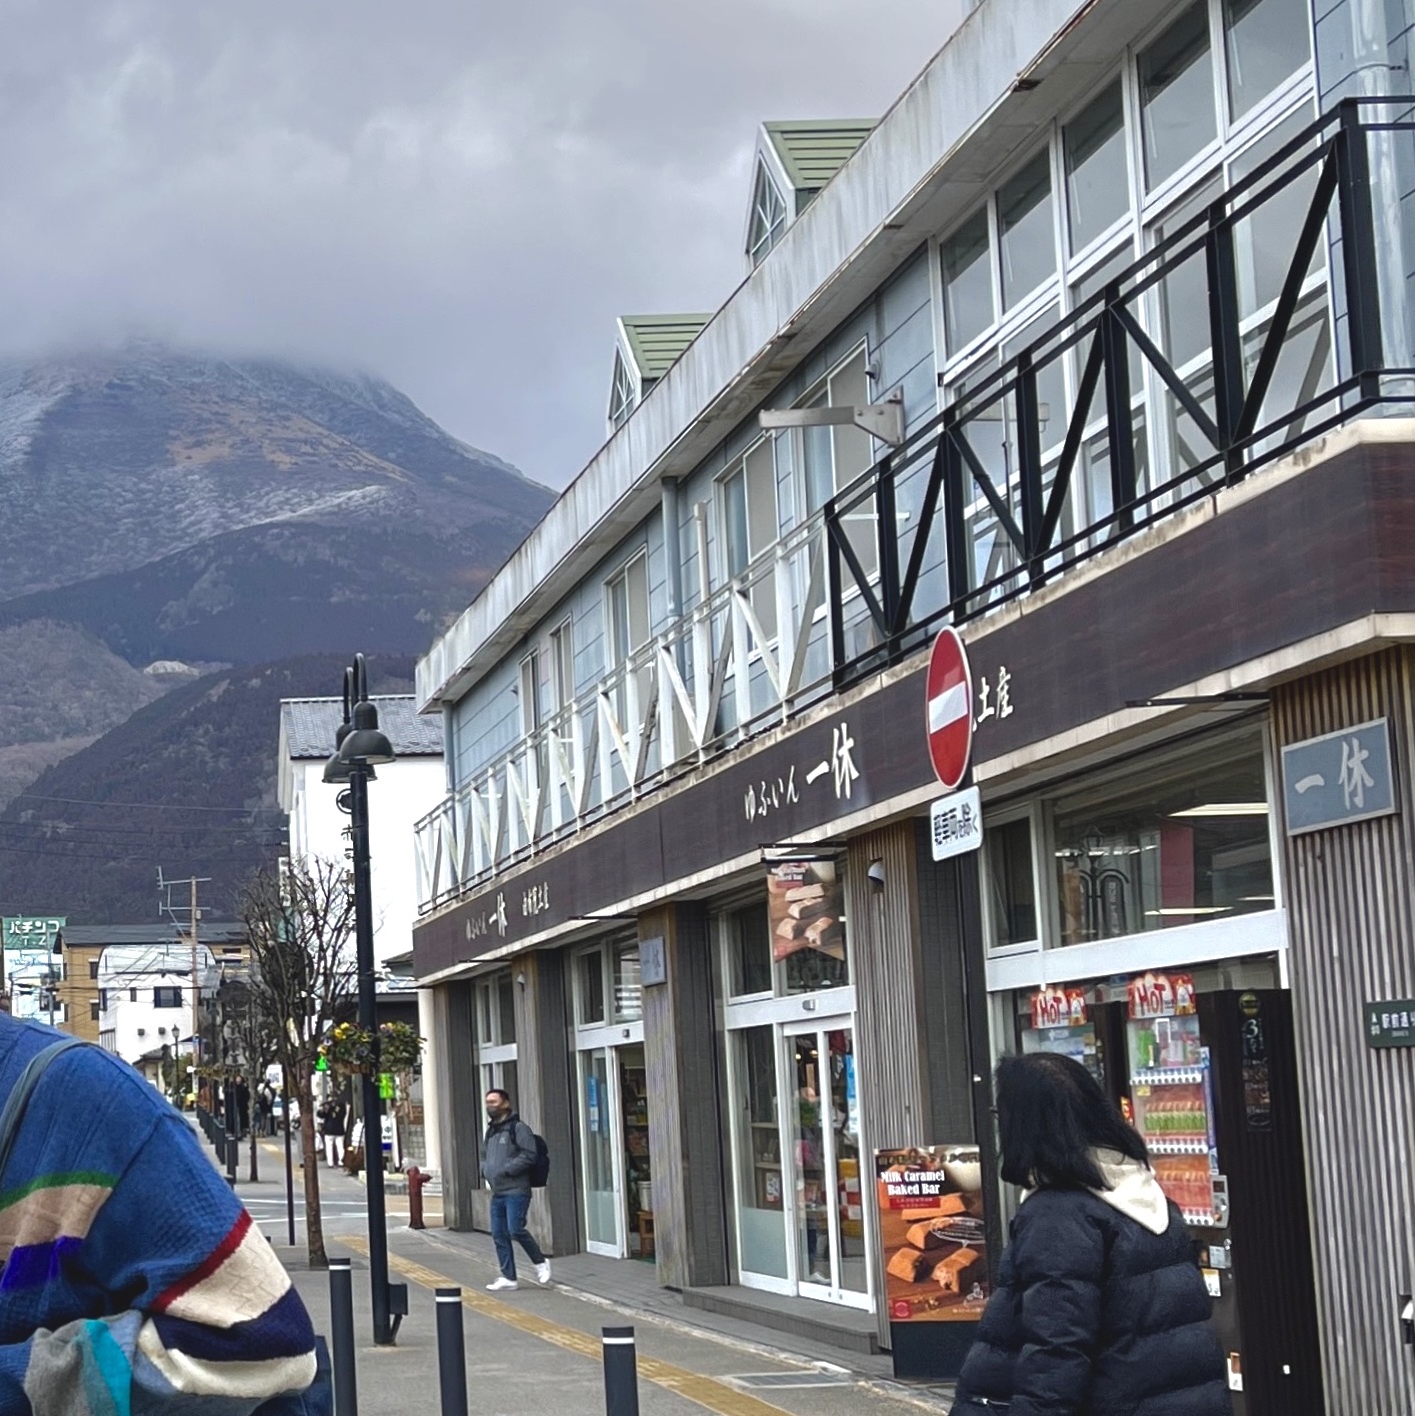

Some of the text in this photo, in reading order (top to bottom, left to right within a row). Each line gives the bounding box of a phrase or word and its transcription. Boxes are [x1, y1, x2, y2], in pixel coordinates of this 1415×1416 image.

[972, 666, 1014, 732] 土産
[744, 722, 860, 823] ゆふいん 一休
[1294, 736, 1375, 811] 一休
[9, 920, 60, 934] パチンコ
[1040, 996, 1062, 1025] HOT
[1138, 983, 1166, 1016] HOT
[881, 1169, 945, 1183] Milk Caramel
[887, 1183, 940, 1196] Baked Bar
